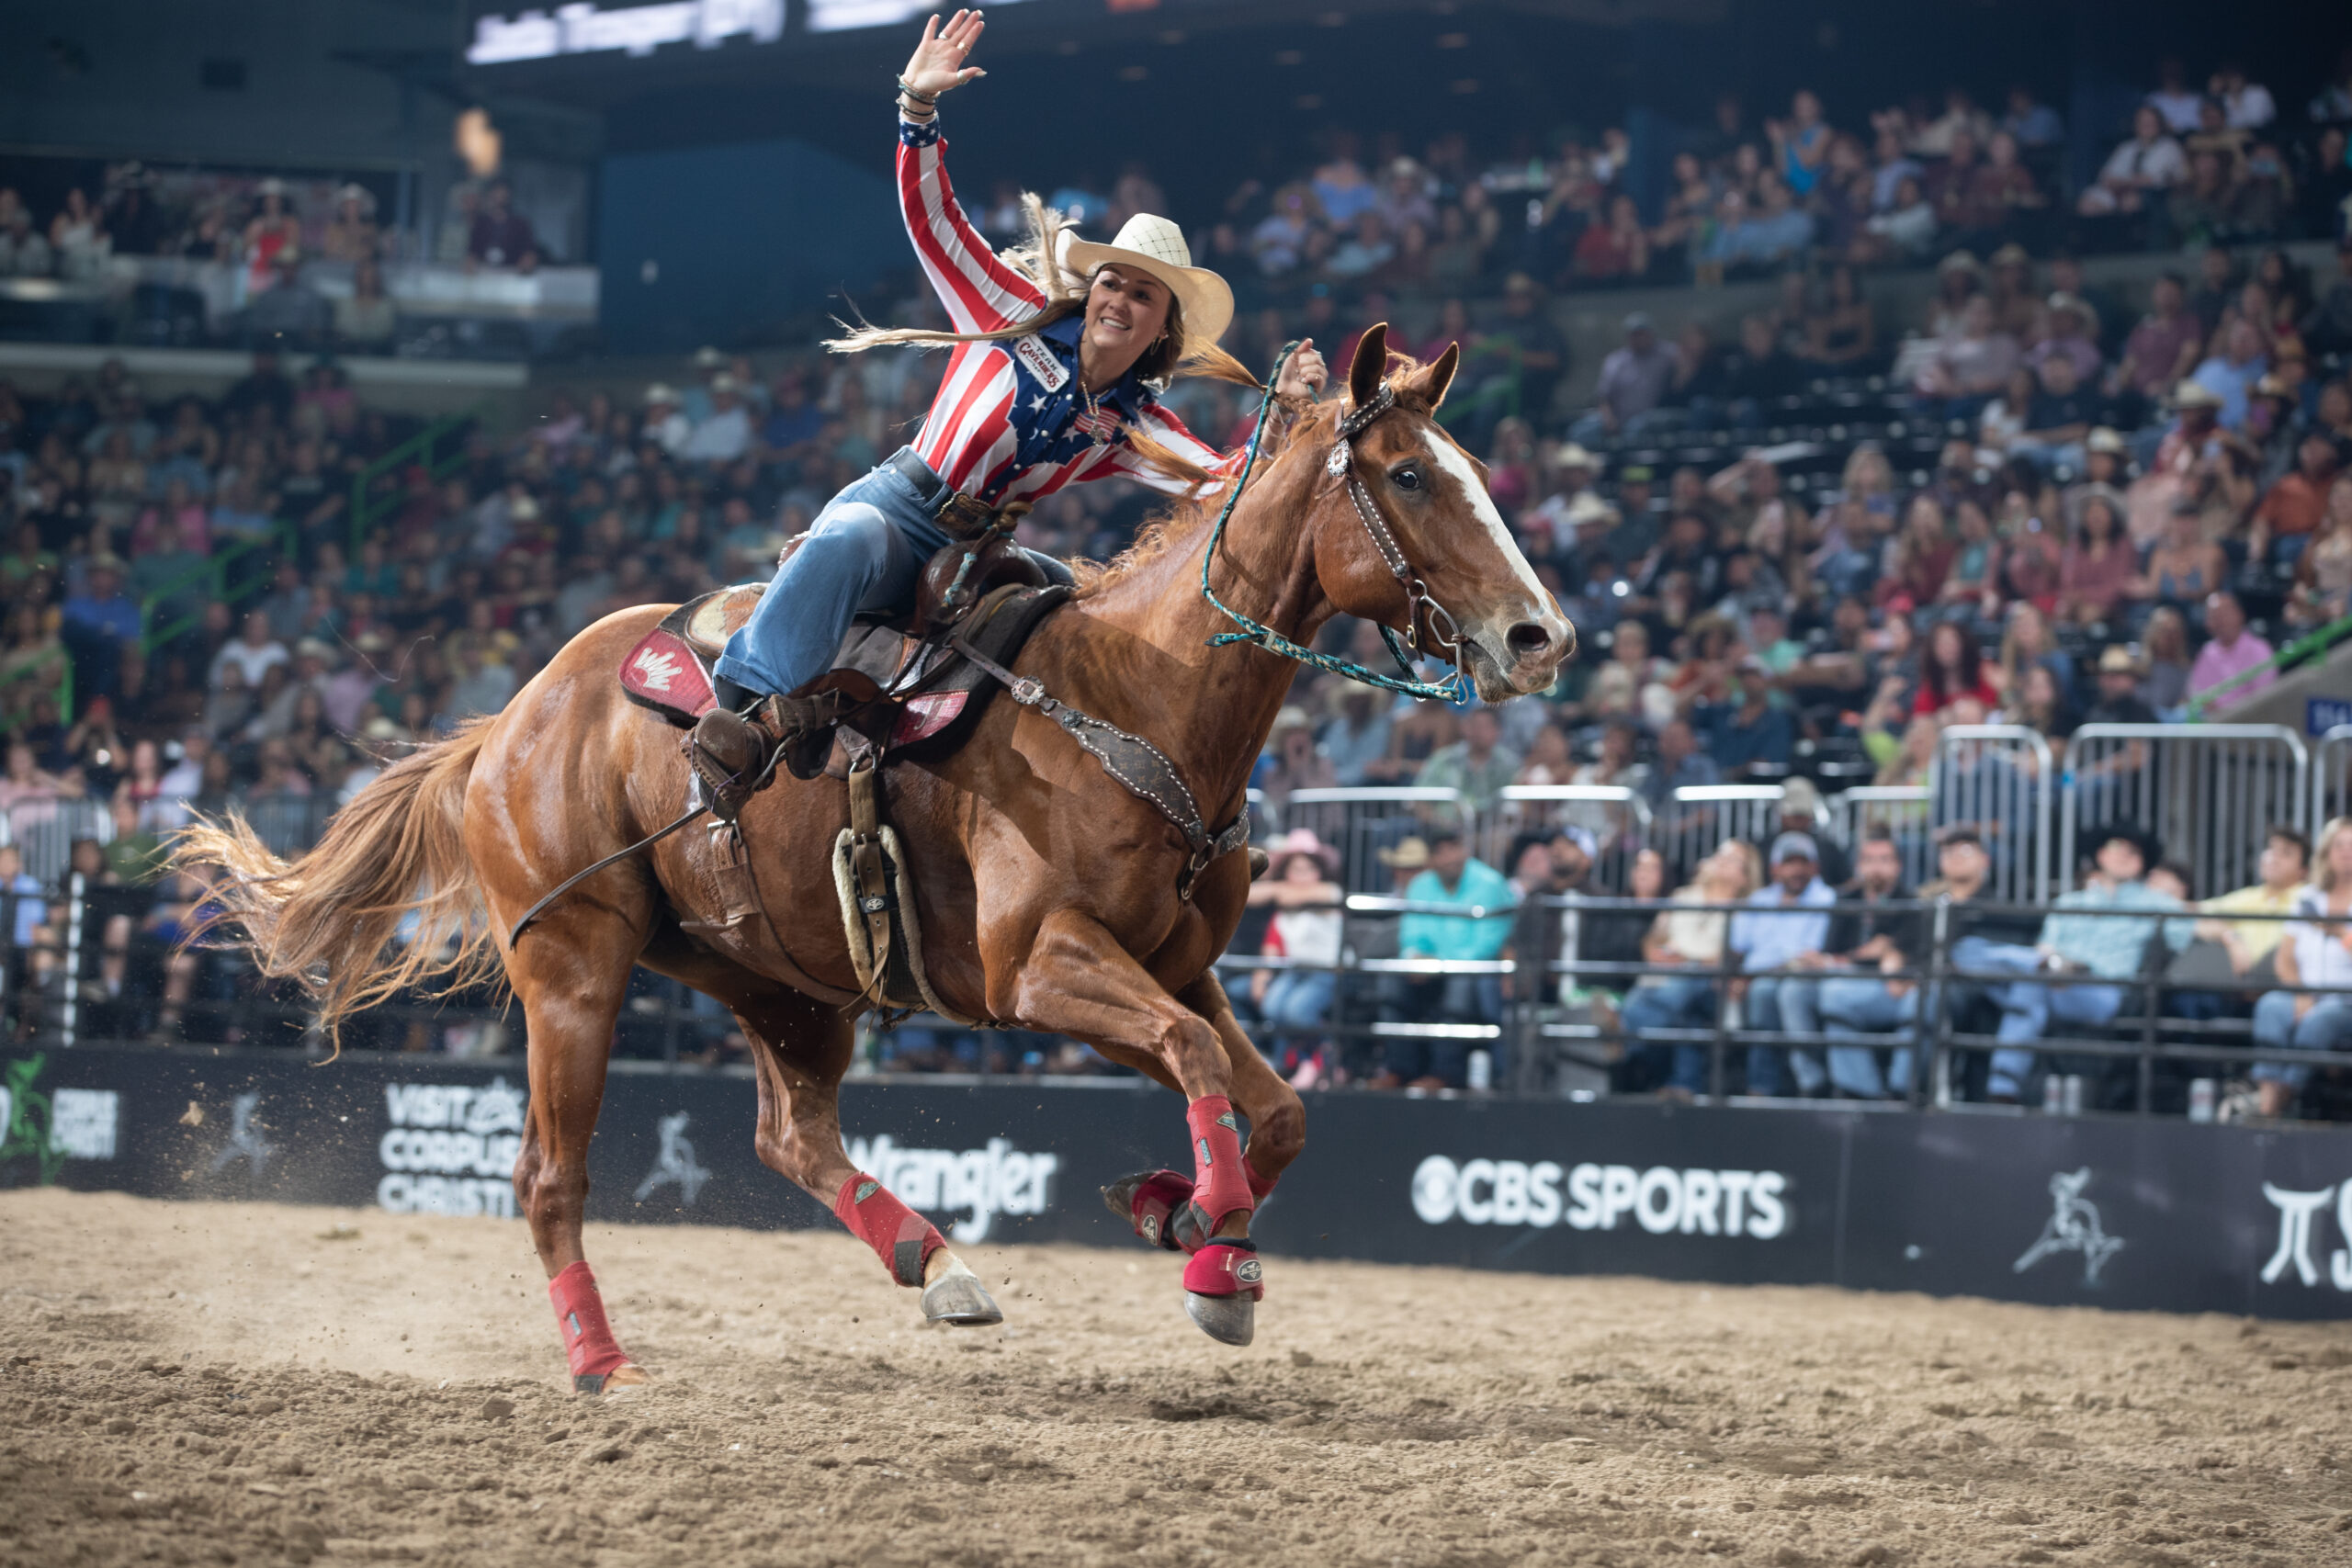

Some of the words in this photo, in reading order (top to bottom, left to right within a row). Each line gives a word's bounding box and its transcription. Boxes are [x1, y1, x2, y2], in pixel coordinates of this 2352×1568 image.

[1036, 345, 1057, 371] TEAM
[386, 1082, 471, 1129] VISIT
[379, 1127, 522, 1179] CORPUS
[378, 1172, 514, 1219] CHRISTI
[840, 1133, 1057, 1243] Wrangler
[1457, 1158, 1562, 1228] CBS
[1566, 1162, 1787, 1240] SPORTS
